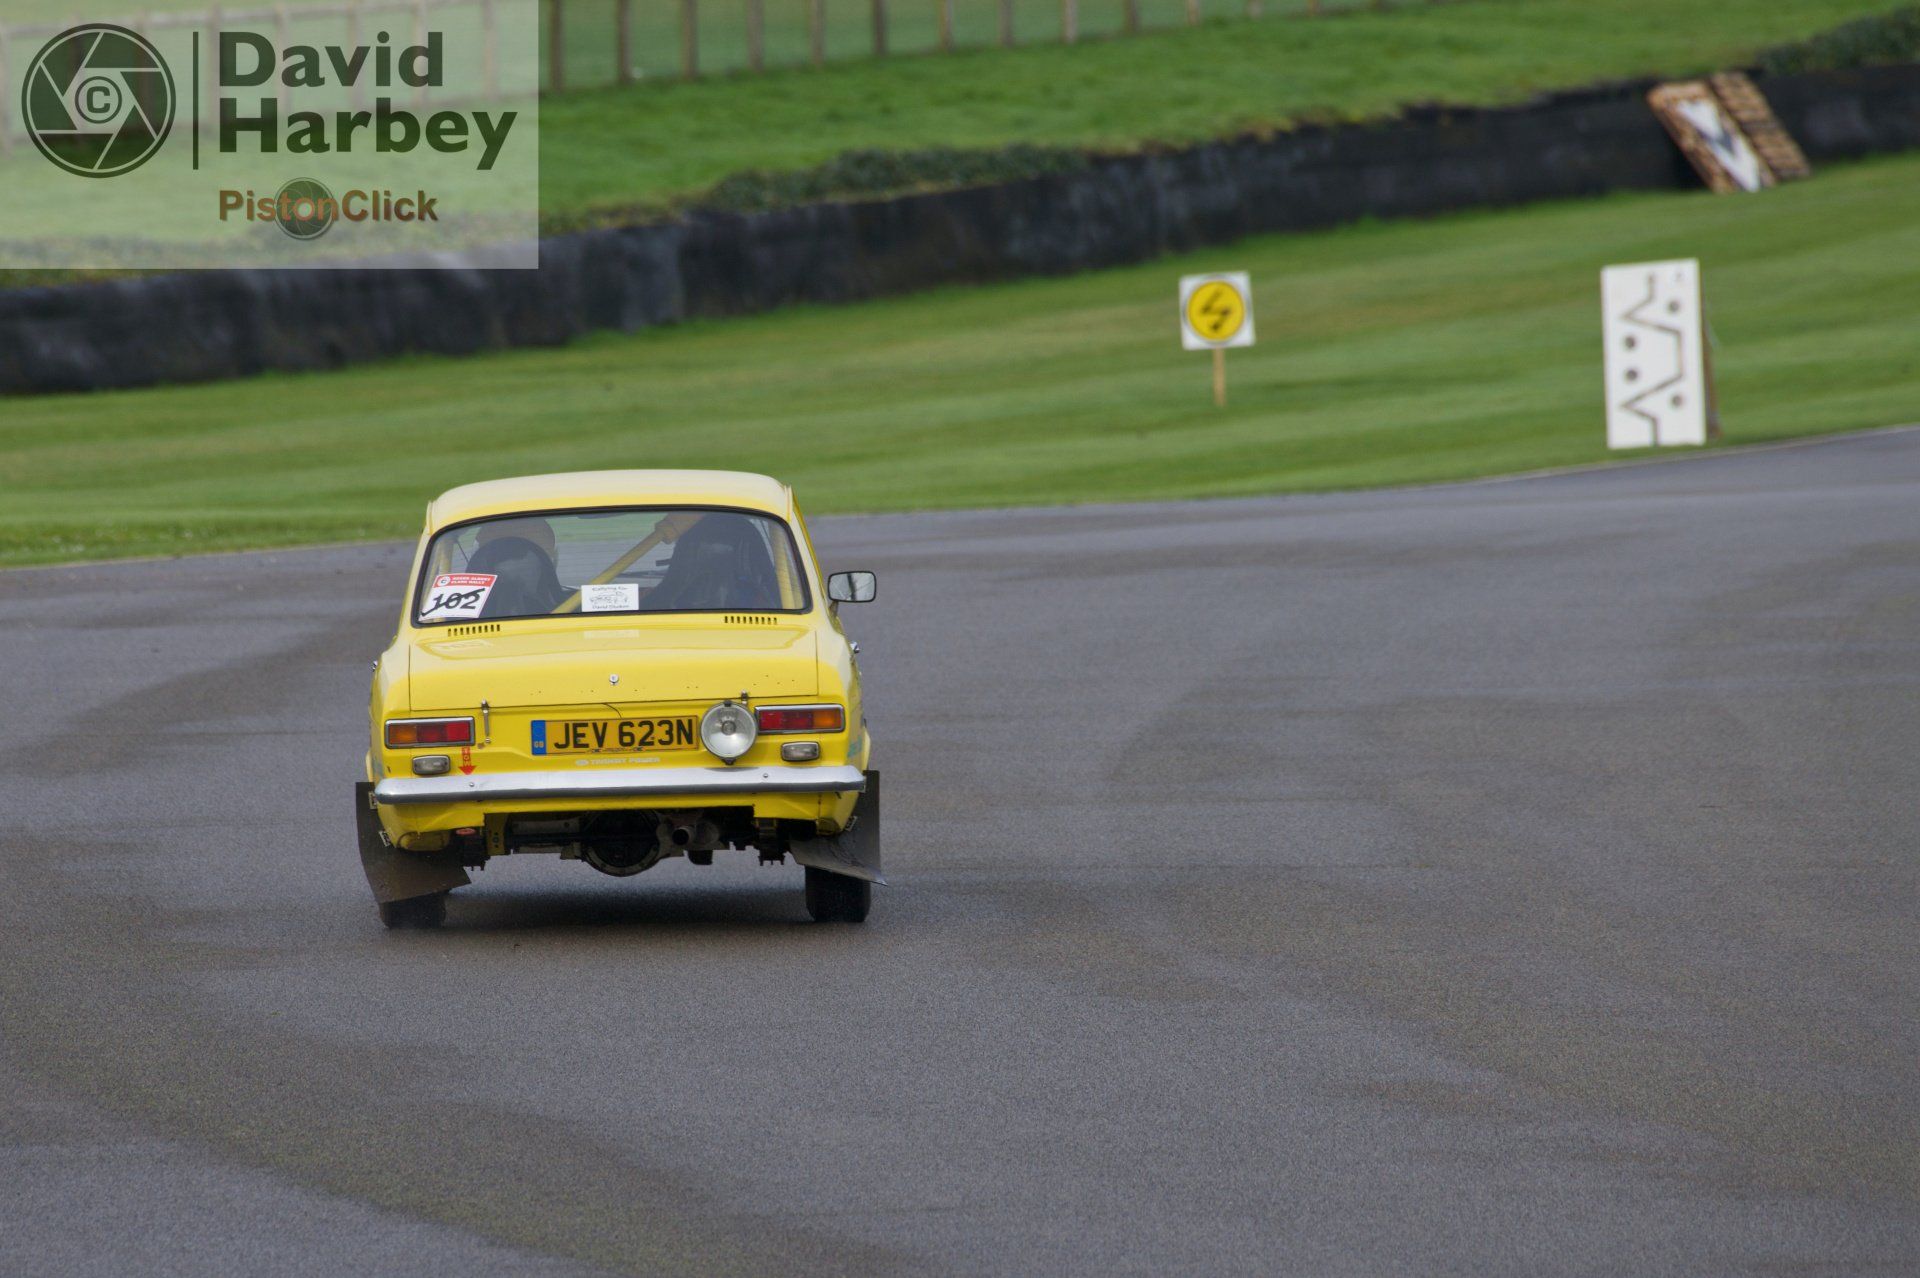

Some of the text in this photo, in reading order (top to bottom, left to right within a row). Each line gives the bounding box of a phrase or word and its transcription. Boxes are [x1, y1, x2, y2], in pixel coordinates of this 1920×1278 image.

[431, 590, 482, 611] 102
[553, 718, 694, 749] JEV 623N
[533, 741, 545, 749] GB
[462, 747, 472, 767] TOW
